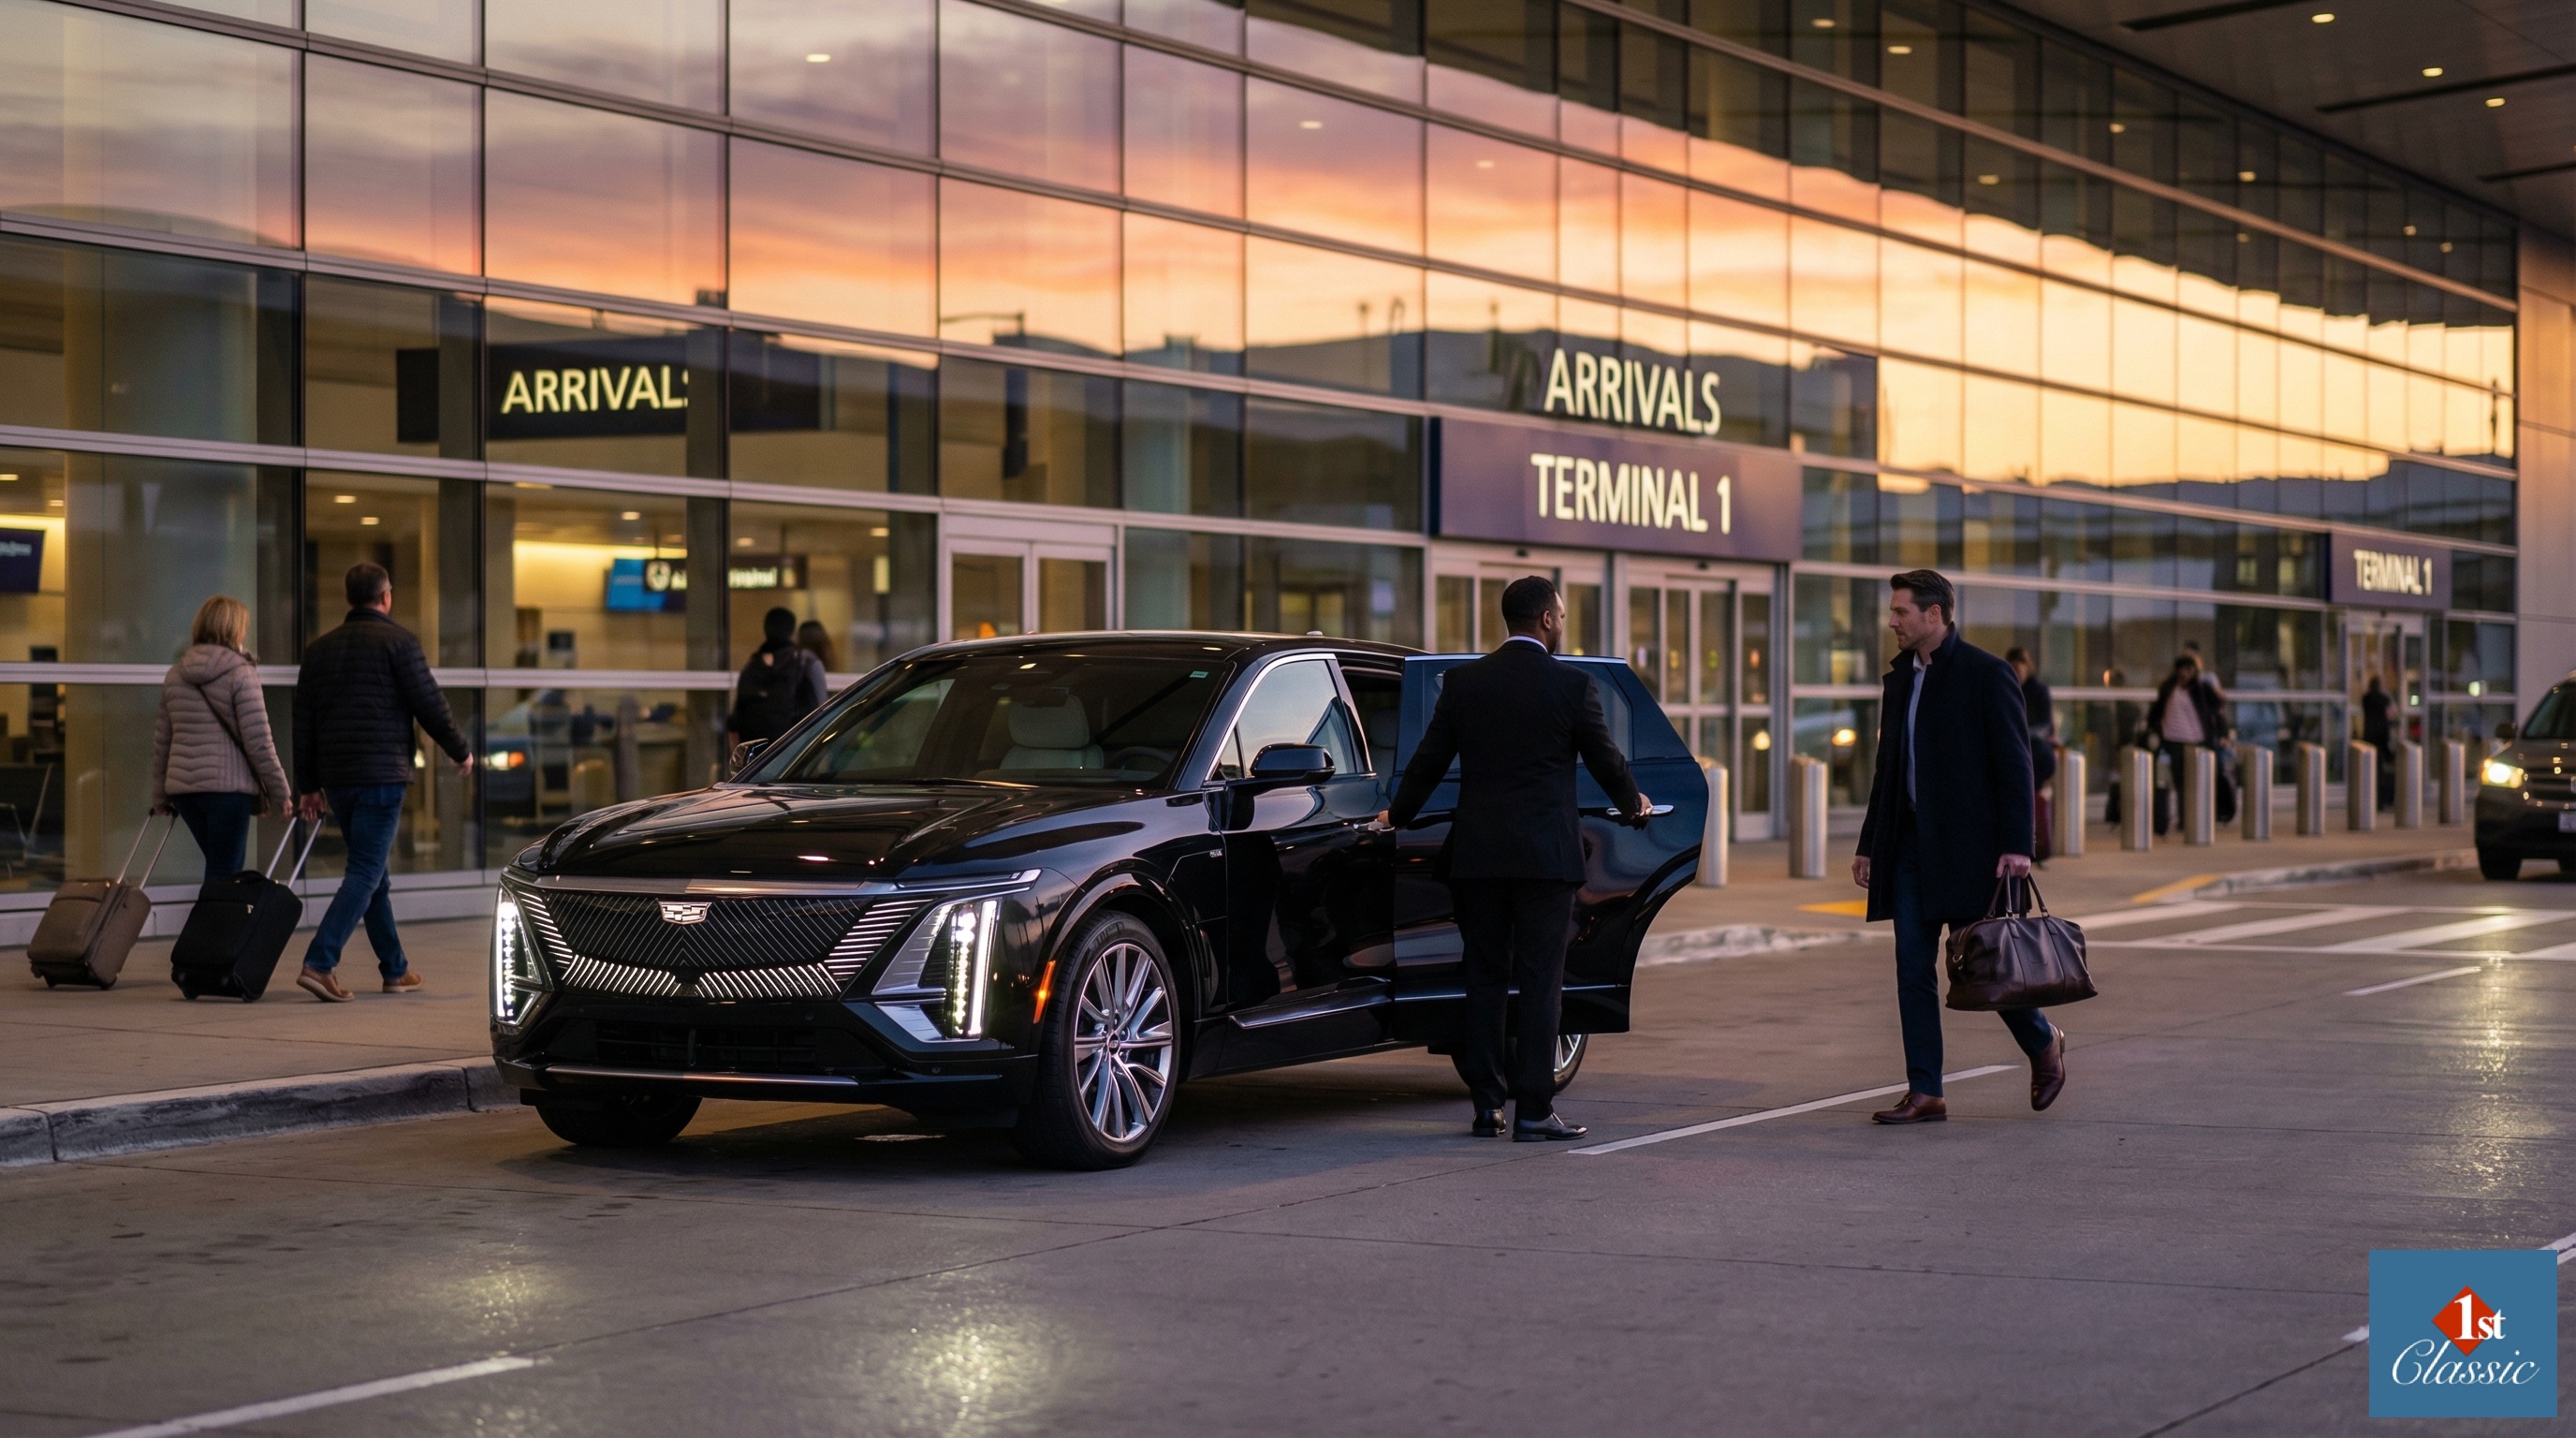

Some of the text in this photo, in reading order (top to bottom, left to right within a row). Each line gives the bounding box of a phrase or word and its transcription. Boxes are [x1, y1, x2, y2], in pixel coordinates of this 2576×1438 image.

[1544, 347, 1722, 436] ARRIVALS
[1530, 453, 1732, 536] TERMINAL 1
[2353, 549, 2433, 596] TERMINAL 1
